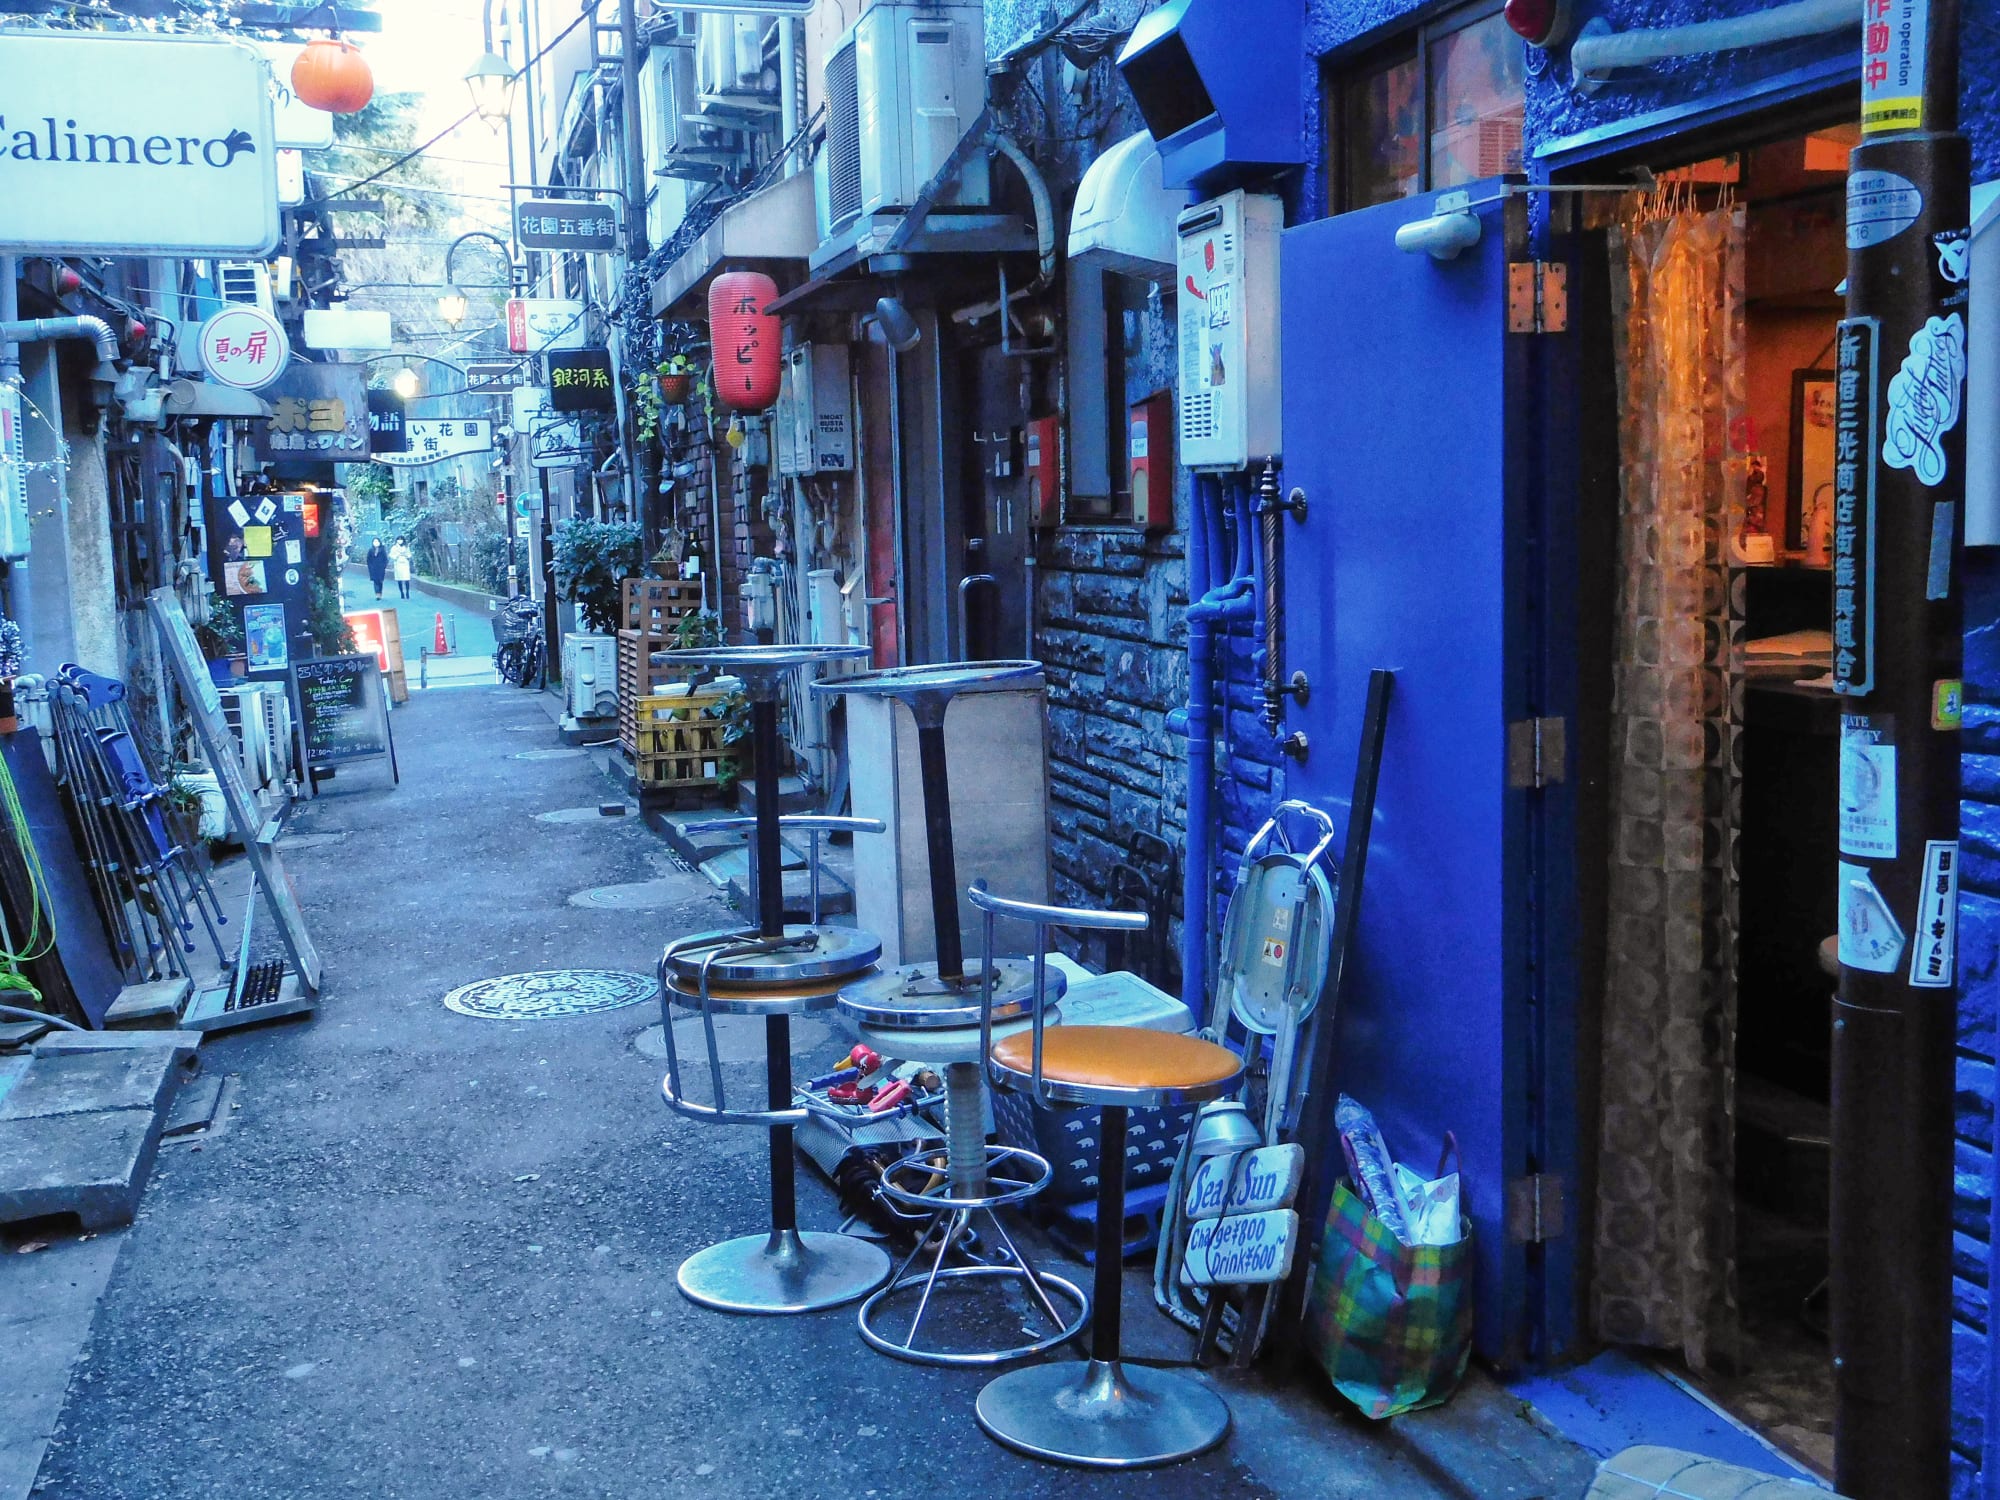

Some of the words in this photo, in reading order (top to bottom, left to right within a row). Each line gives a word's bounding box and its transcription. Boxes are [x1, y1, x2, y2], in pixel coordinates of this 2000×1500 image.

[1898, 21, 1912, 87] operation
[521, 215, 615, 237] 花園五番街
[215, 330, 268, 365] 夏の扉
[733, 290, 760, 391] ホッピー
[551, 367, 610, 389] 銀河系
[1187, 1163, 1224, 1216] Sea
[1236, 1155, 1278, 1206] Sun
